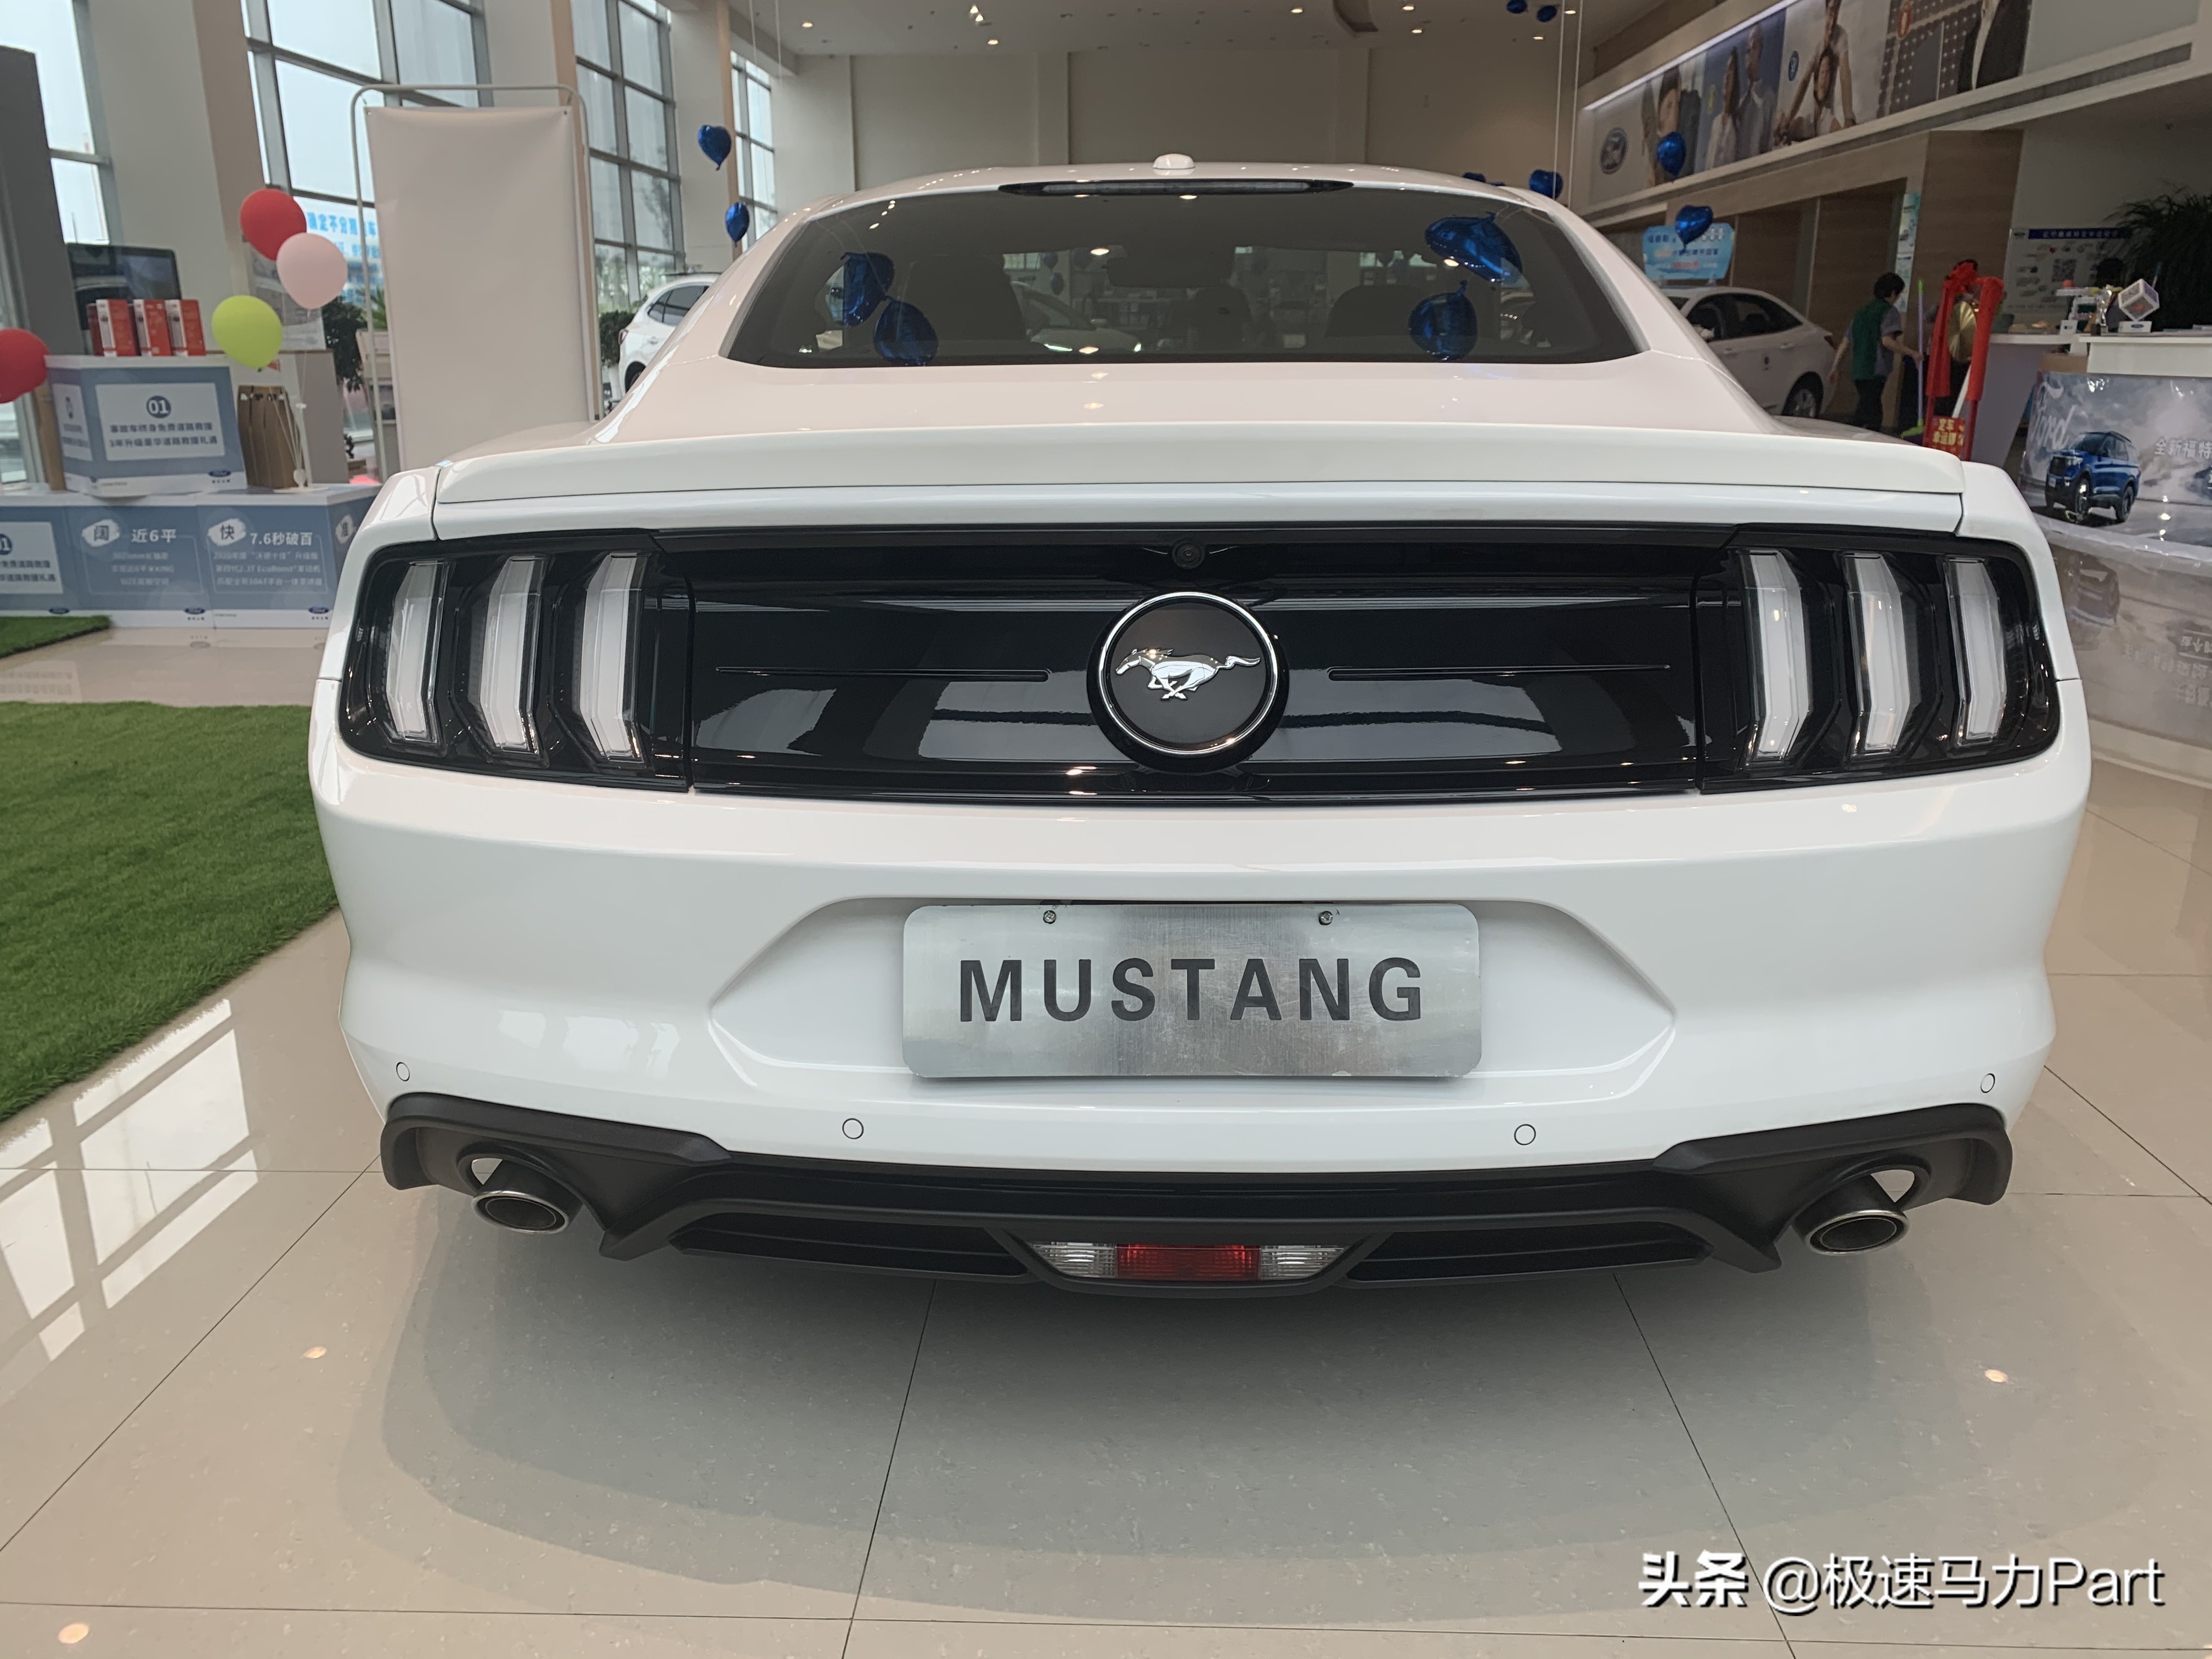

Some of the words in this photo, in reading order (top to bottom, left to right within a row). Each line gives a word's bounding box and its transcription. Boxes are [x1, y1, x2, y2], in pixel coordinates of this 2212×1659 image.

[148, 399, 169, 414] 01
[2154, 436, 2212, 460] 全新福特
[131, 528, 177, 543] 近6平
[220, 524, 234, 540] 快
[250, 532, 313, 546] 7.6秒破百
[0, 538, 10, 551] 1
[960, 957, 1421, 1022] MUSTANG
